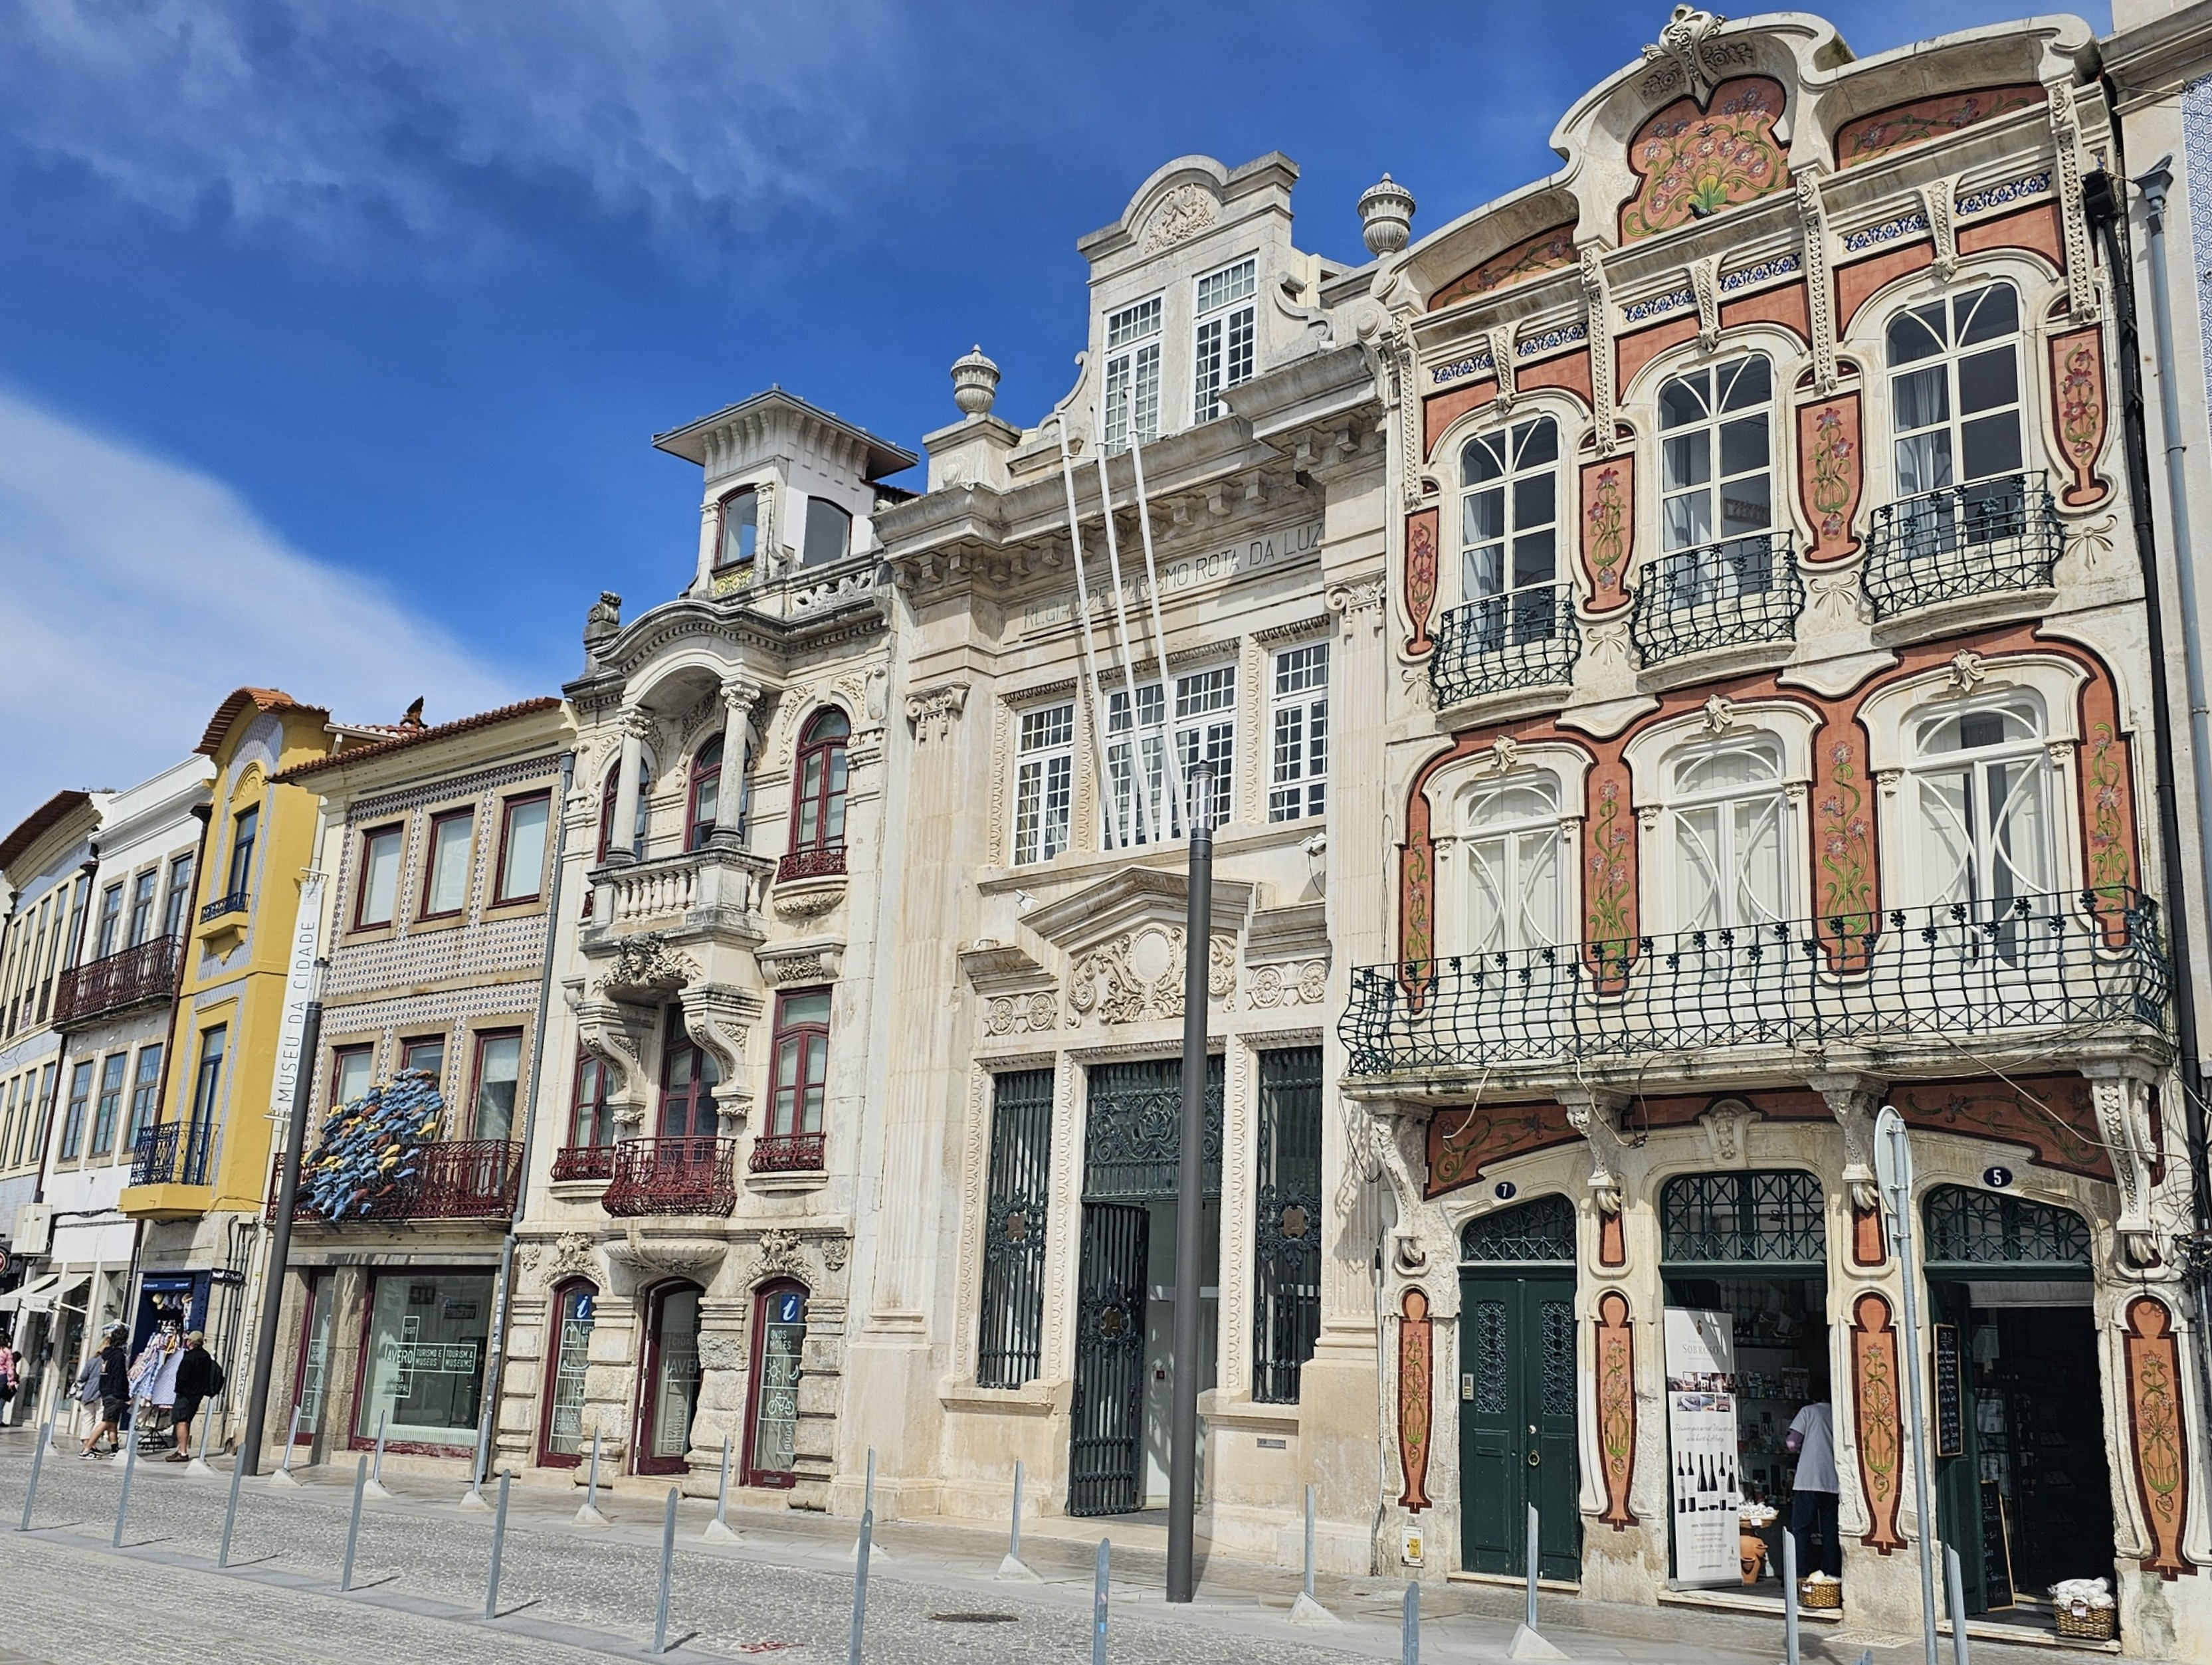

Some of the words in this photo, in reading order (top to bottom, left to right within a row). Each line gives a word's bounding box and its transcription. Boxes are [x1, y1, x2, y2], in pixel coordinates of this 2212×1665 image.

[1195, 549, 1240, 582] ROTA
[1249, 539, 1275, 566] DA
[1284, 523, 1324, 556] LUZ
[293, 921, 315, 990] CIDADE
[288, 1001, 306, 1025] DA
[278, 1036, 300, 1103] MUSEU
[1993, 1169, 2001, 1185] 5
[1502, 1184, 1508, 1197] 7
[770, 1329, 787, 1339] OVOS
[769, 1340, 791, 1350] MOLES
